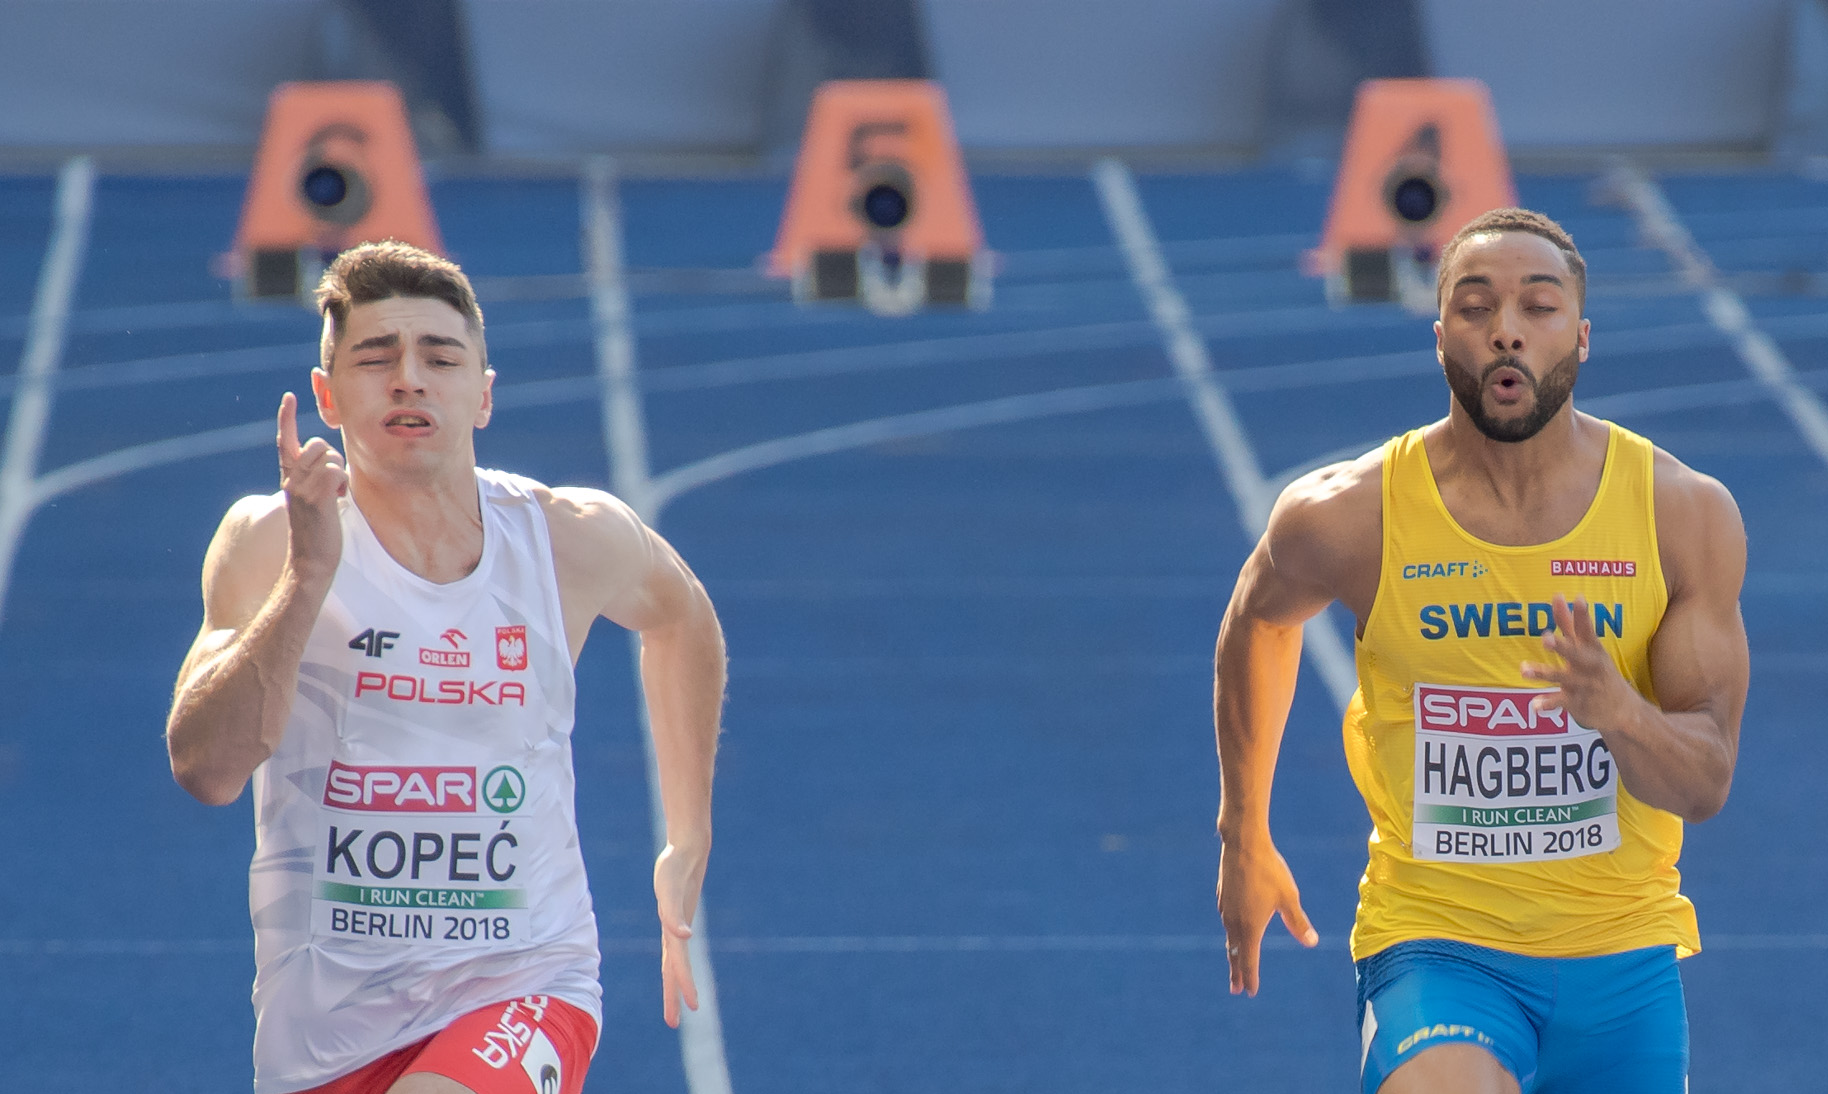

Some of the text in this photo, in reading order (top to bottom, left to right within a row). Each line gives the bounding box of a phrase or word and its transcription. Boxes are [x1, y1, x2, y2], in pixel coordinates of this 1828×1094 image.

[1403, 562, 1469, 579] CRAFT
[1551, 560, 1636, 577] BAUHAUS
[1420, 603, 1623, 640] SWEDN
[348, 628, 400, 658] 4F
[421, 650, 469, 666] ORLEN
[355, 671, 525, 706] POLSKA
[1423, 694, 1565, 730] SPAR
[1424, 738, 1610, 799] HAGBERG
[328, 772, 473, 806] SPAR
[1462, 808, 1467, 823] I
[1472, 809, 1509, 824] RUN
[326, 820, 518, 882] KOPEĆ
[1435, 824, 1603, 857] BERLIN 2018
[360, 889, 364, 902] I
[370, 891, 411, 905] RUN
[331, 908, 510, 940] BERLIN 2018
[1397, 1023, 1475, 1055] CRAFT
